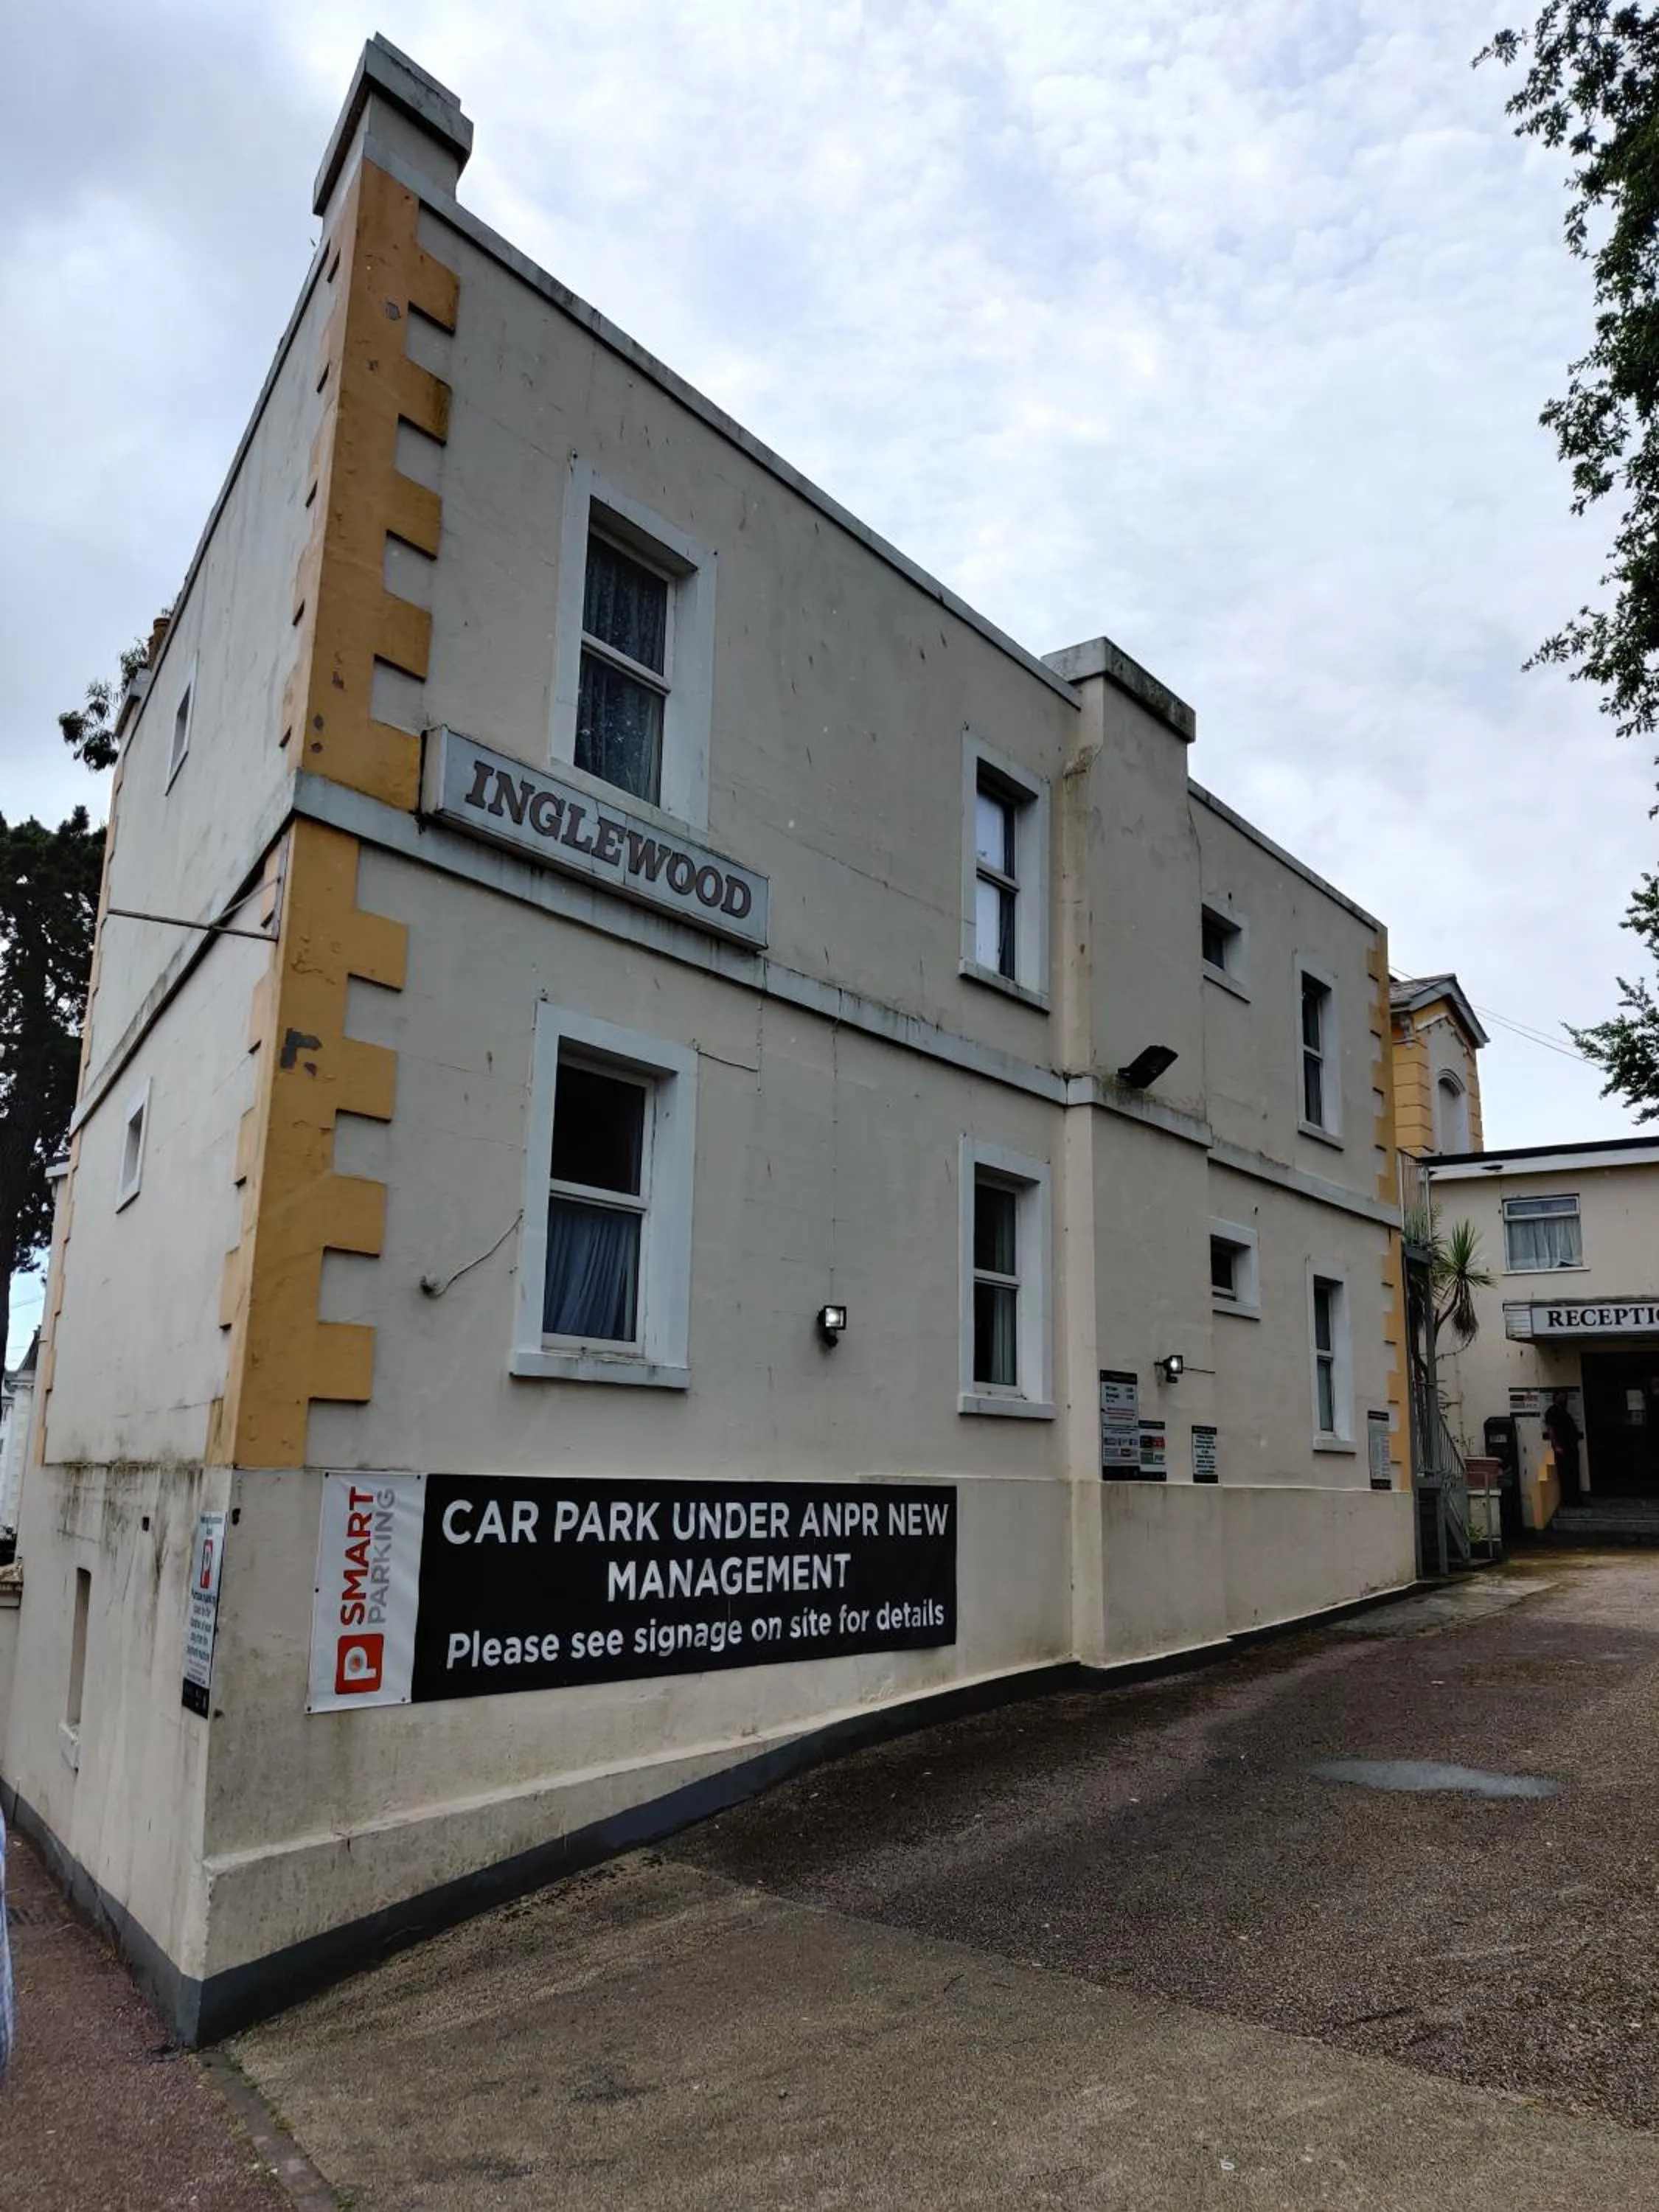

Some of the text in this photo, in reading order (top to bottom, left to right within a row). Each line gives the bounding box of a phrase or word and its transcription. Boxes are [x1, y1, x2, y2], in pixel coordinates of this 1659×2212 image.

[464, 759, 751, 919] INGLEWOOD
[1546, 1307, 1659, 1327] RECEPTI
[341, 1486, 374, 1626] SMART
[368, 1488, 395, 1624] PARKING
[442, 1499, 949, 1545] CAR PARK UNDER ANPR NEW
[608, 1553, 851, 1602] MANAGEMENT
[446, 1598, 945, 1670] Please see signage on site for details
